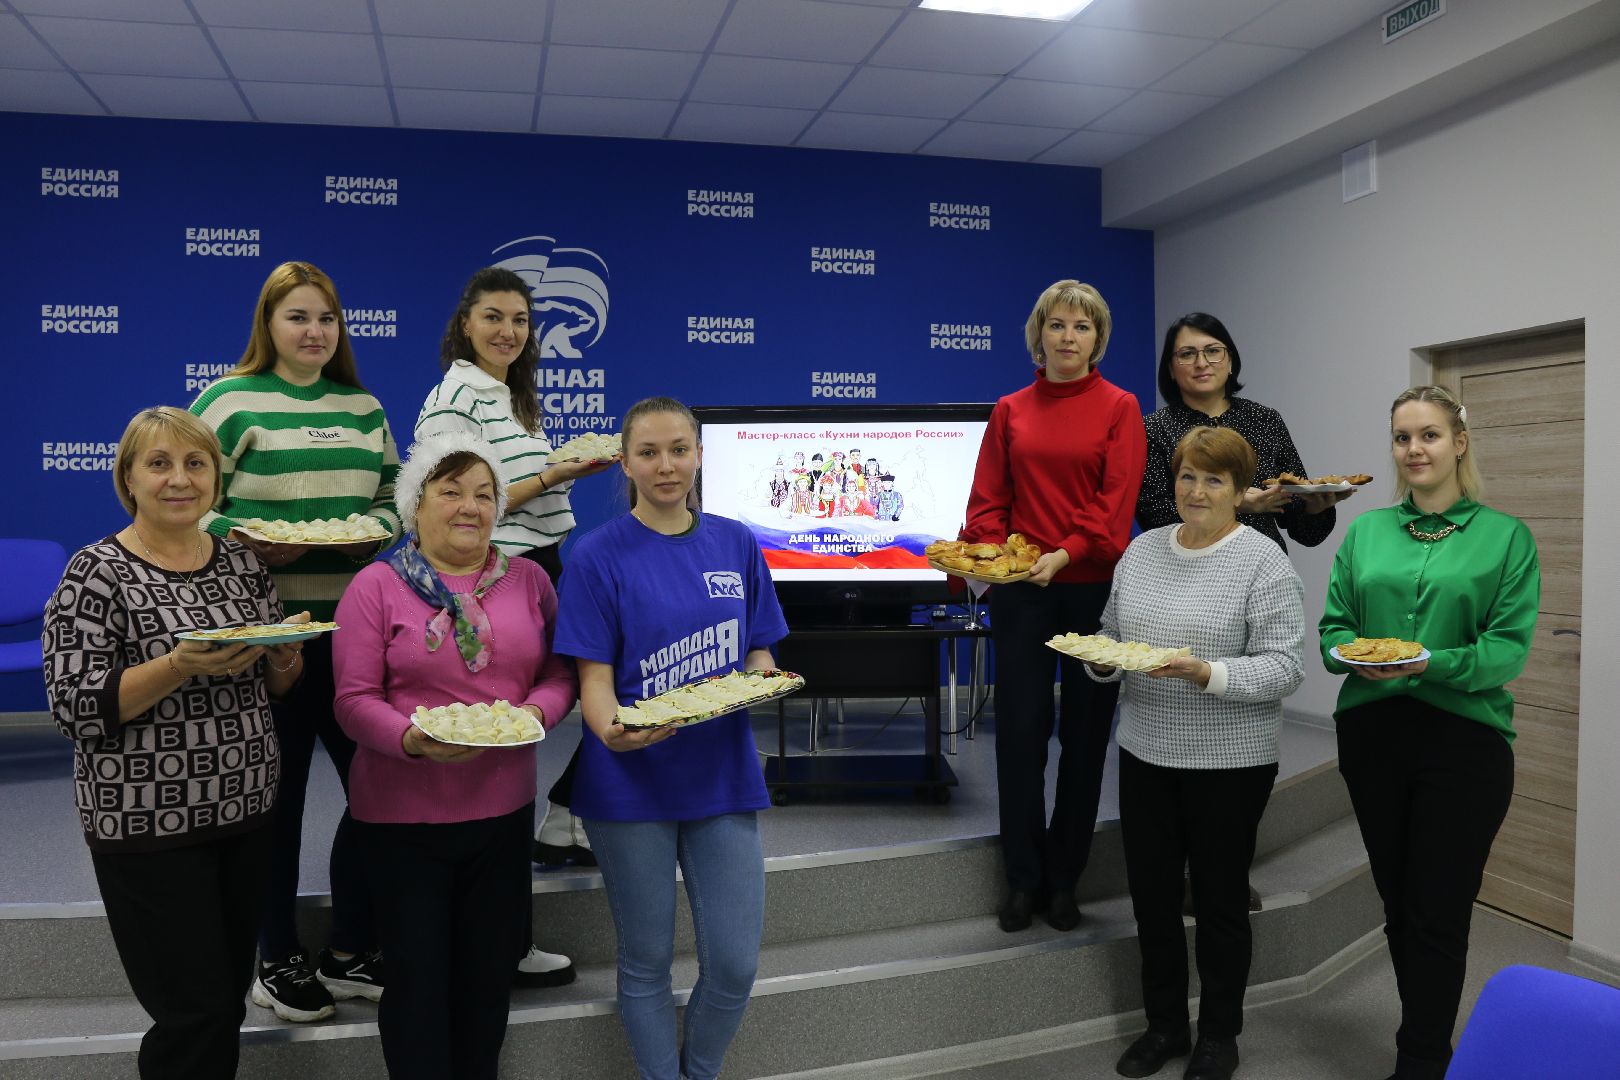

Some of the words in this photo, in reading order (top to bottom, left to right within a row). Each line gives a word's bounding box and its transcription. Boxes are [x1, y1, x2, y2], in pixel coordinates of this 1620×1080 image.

[1389, 0, 1440, 34] ВЫХОД
[42, 168, 118, 182] ЕДИНАЯ
[326, 176, 397, 190] ЕДИНАЯ
[42, 183, 118, 197] РОССИЯ
[688, 190, 753, 203] ЕДИНАЯ
[326, 191, 397, 205] РОССИЯ
[688, 203, 753, 217] РОССИЯ
[930, 203, 990, 217] ЕДИНАЯ
[930, 216, 990, 230] РОССИЯ
[186, 228, 259, 241] ЕДИНАЯ
[186, 242, 259, 256] РОССИЯ
[812, 247, 875, 260] ЕДИНАЯ
[812, 261, 875, 275] РОССИЯ
[42, 305, 118, 318] ЕДИНАЯ
[342, 309, 397, 323] ИНАЯ
[42, 320, 118, 334] РОССИЯ
[688, 317, 754, 330] ЕДИНАЯ
[931, 324, 991, 336] ЕДИНАЯ
[346, 324, 397, 337] ССИЯ
[688, 331, 754, 344] РОССИЯ
[931, 337, 991, 350] РОССИЯ
[186, 364, 236, 377] ЕДИН
[812, 372, 876, 384] ЕДИНАЯ
[812, 385, 876, 398] РОССИЯ
[537, 393, 605, 414] СИЯ
[568, 416, 616, 429] ОКРУГ
[737, 431, 816, 441] Мастер-класс
[818, 430, 860, 440] «Кухни
[863, 430, 912, 440] народов
[915, 429, 964, 438] России»
[43, 443, 119, 456] ЕДИНАЯ
[788, 533, 820, 544] ДЕНЬ
[823, 533, 895, 544] НАРОДНОГО
[812, 544, 873, 553] ЕДИНСТВА
[290, 955, 303, 963] CK
